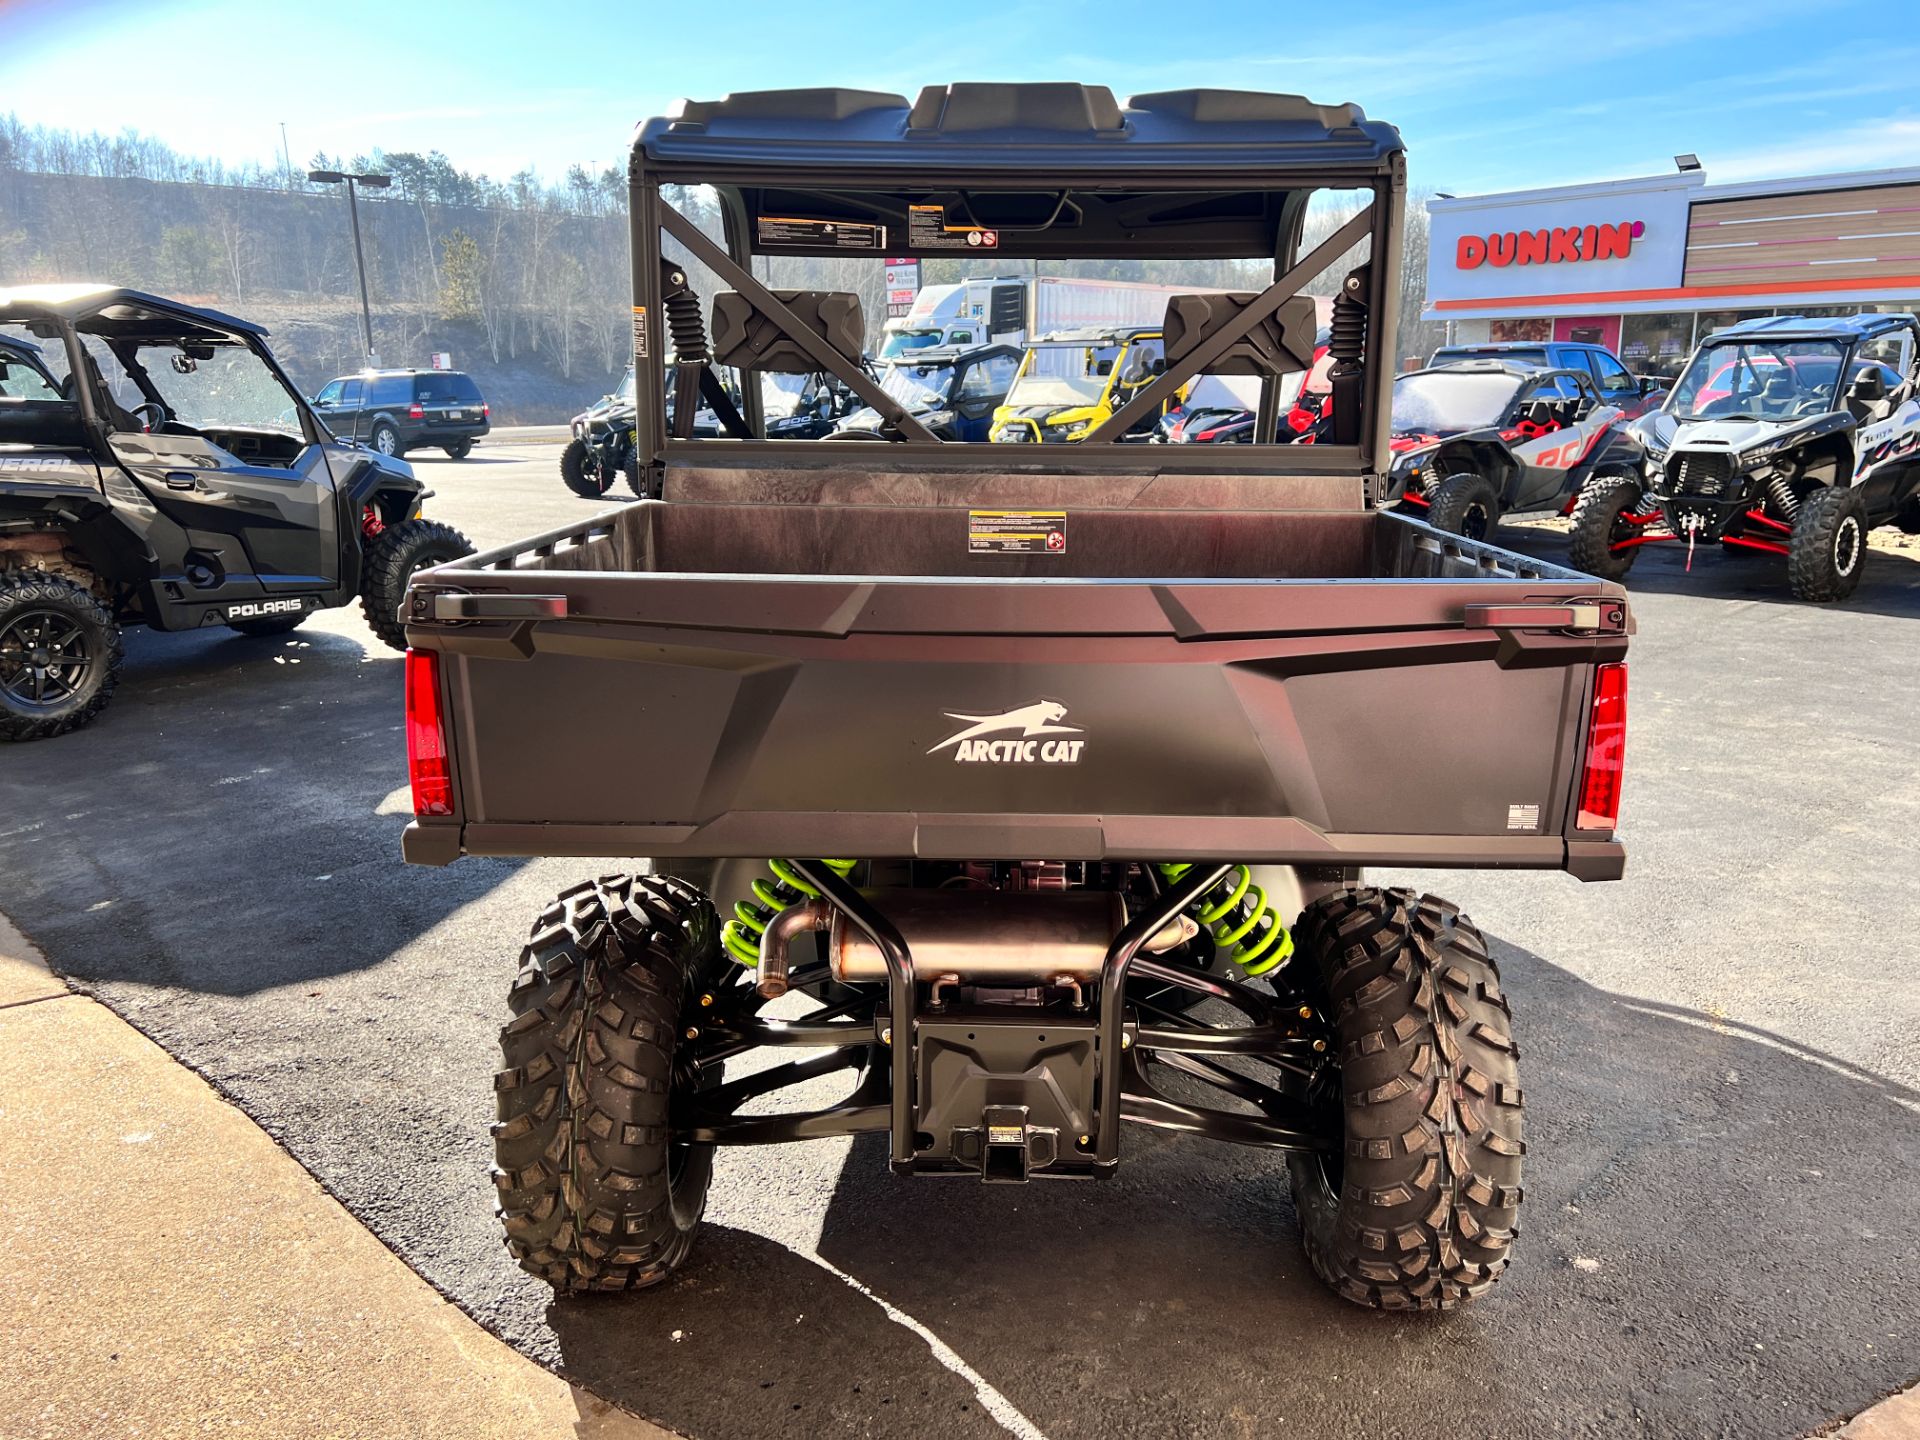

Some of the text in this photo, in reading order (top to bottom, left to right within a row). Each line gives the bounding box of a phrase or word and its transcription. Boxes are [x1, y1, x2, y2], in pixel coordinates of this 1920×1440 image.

[228, 598, 302, 619] POLARIS
[954, 739, 1085, 763] ARCTIC CAT
